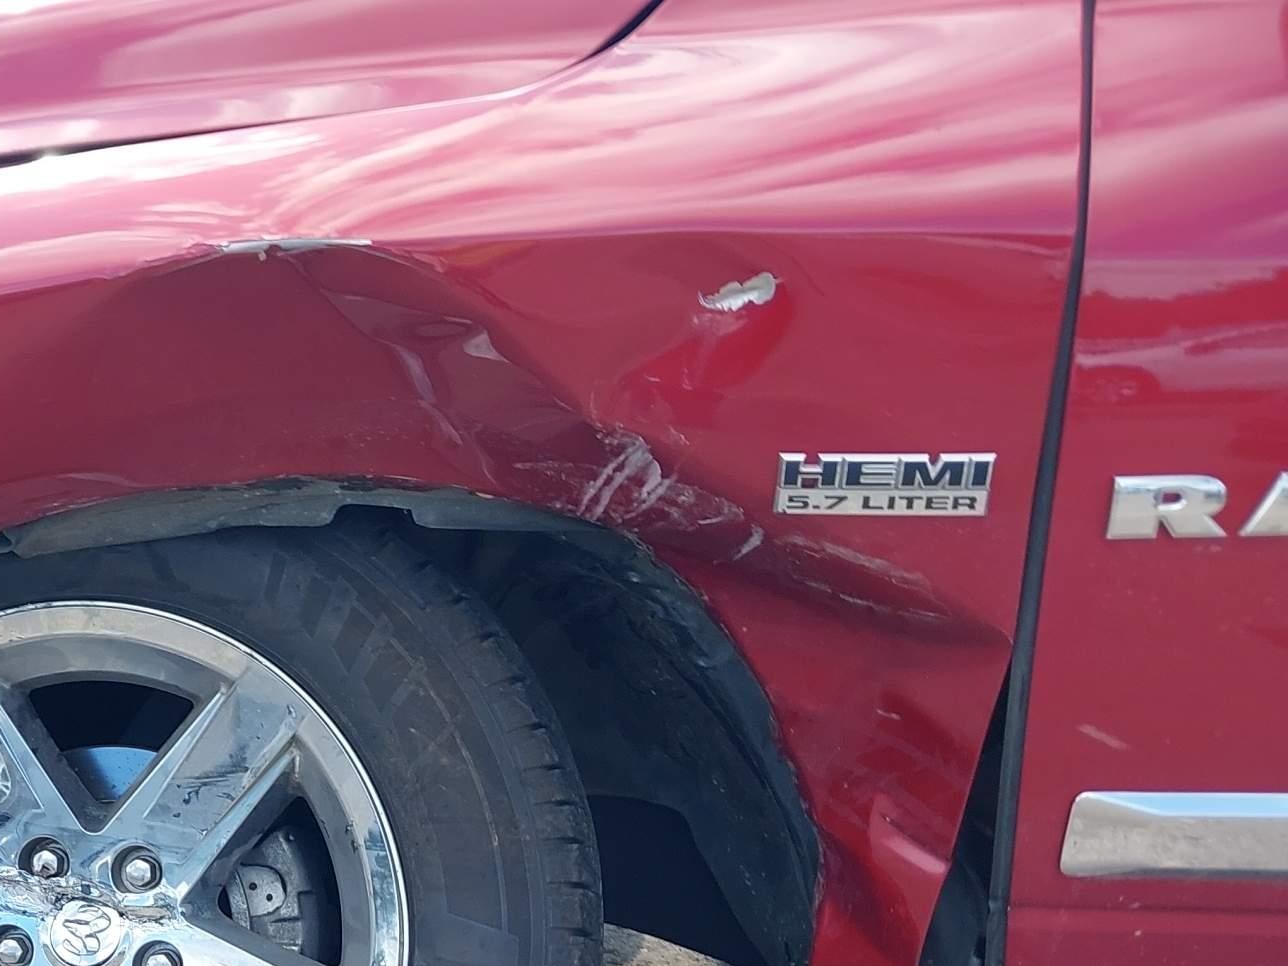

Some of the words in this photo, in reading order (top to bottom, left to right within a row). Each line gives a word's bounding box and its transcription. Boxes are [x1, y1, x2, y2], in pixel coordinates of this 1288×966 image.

[778, 452, 997, 489] HEMI
[785, 495, 849, 511] 5.7
[861, 495, 979, 511] LITER
